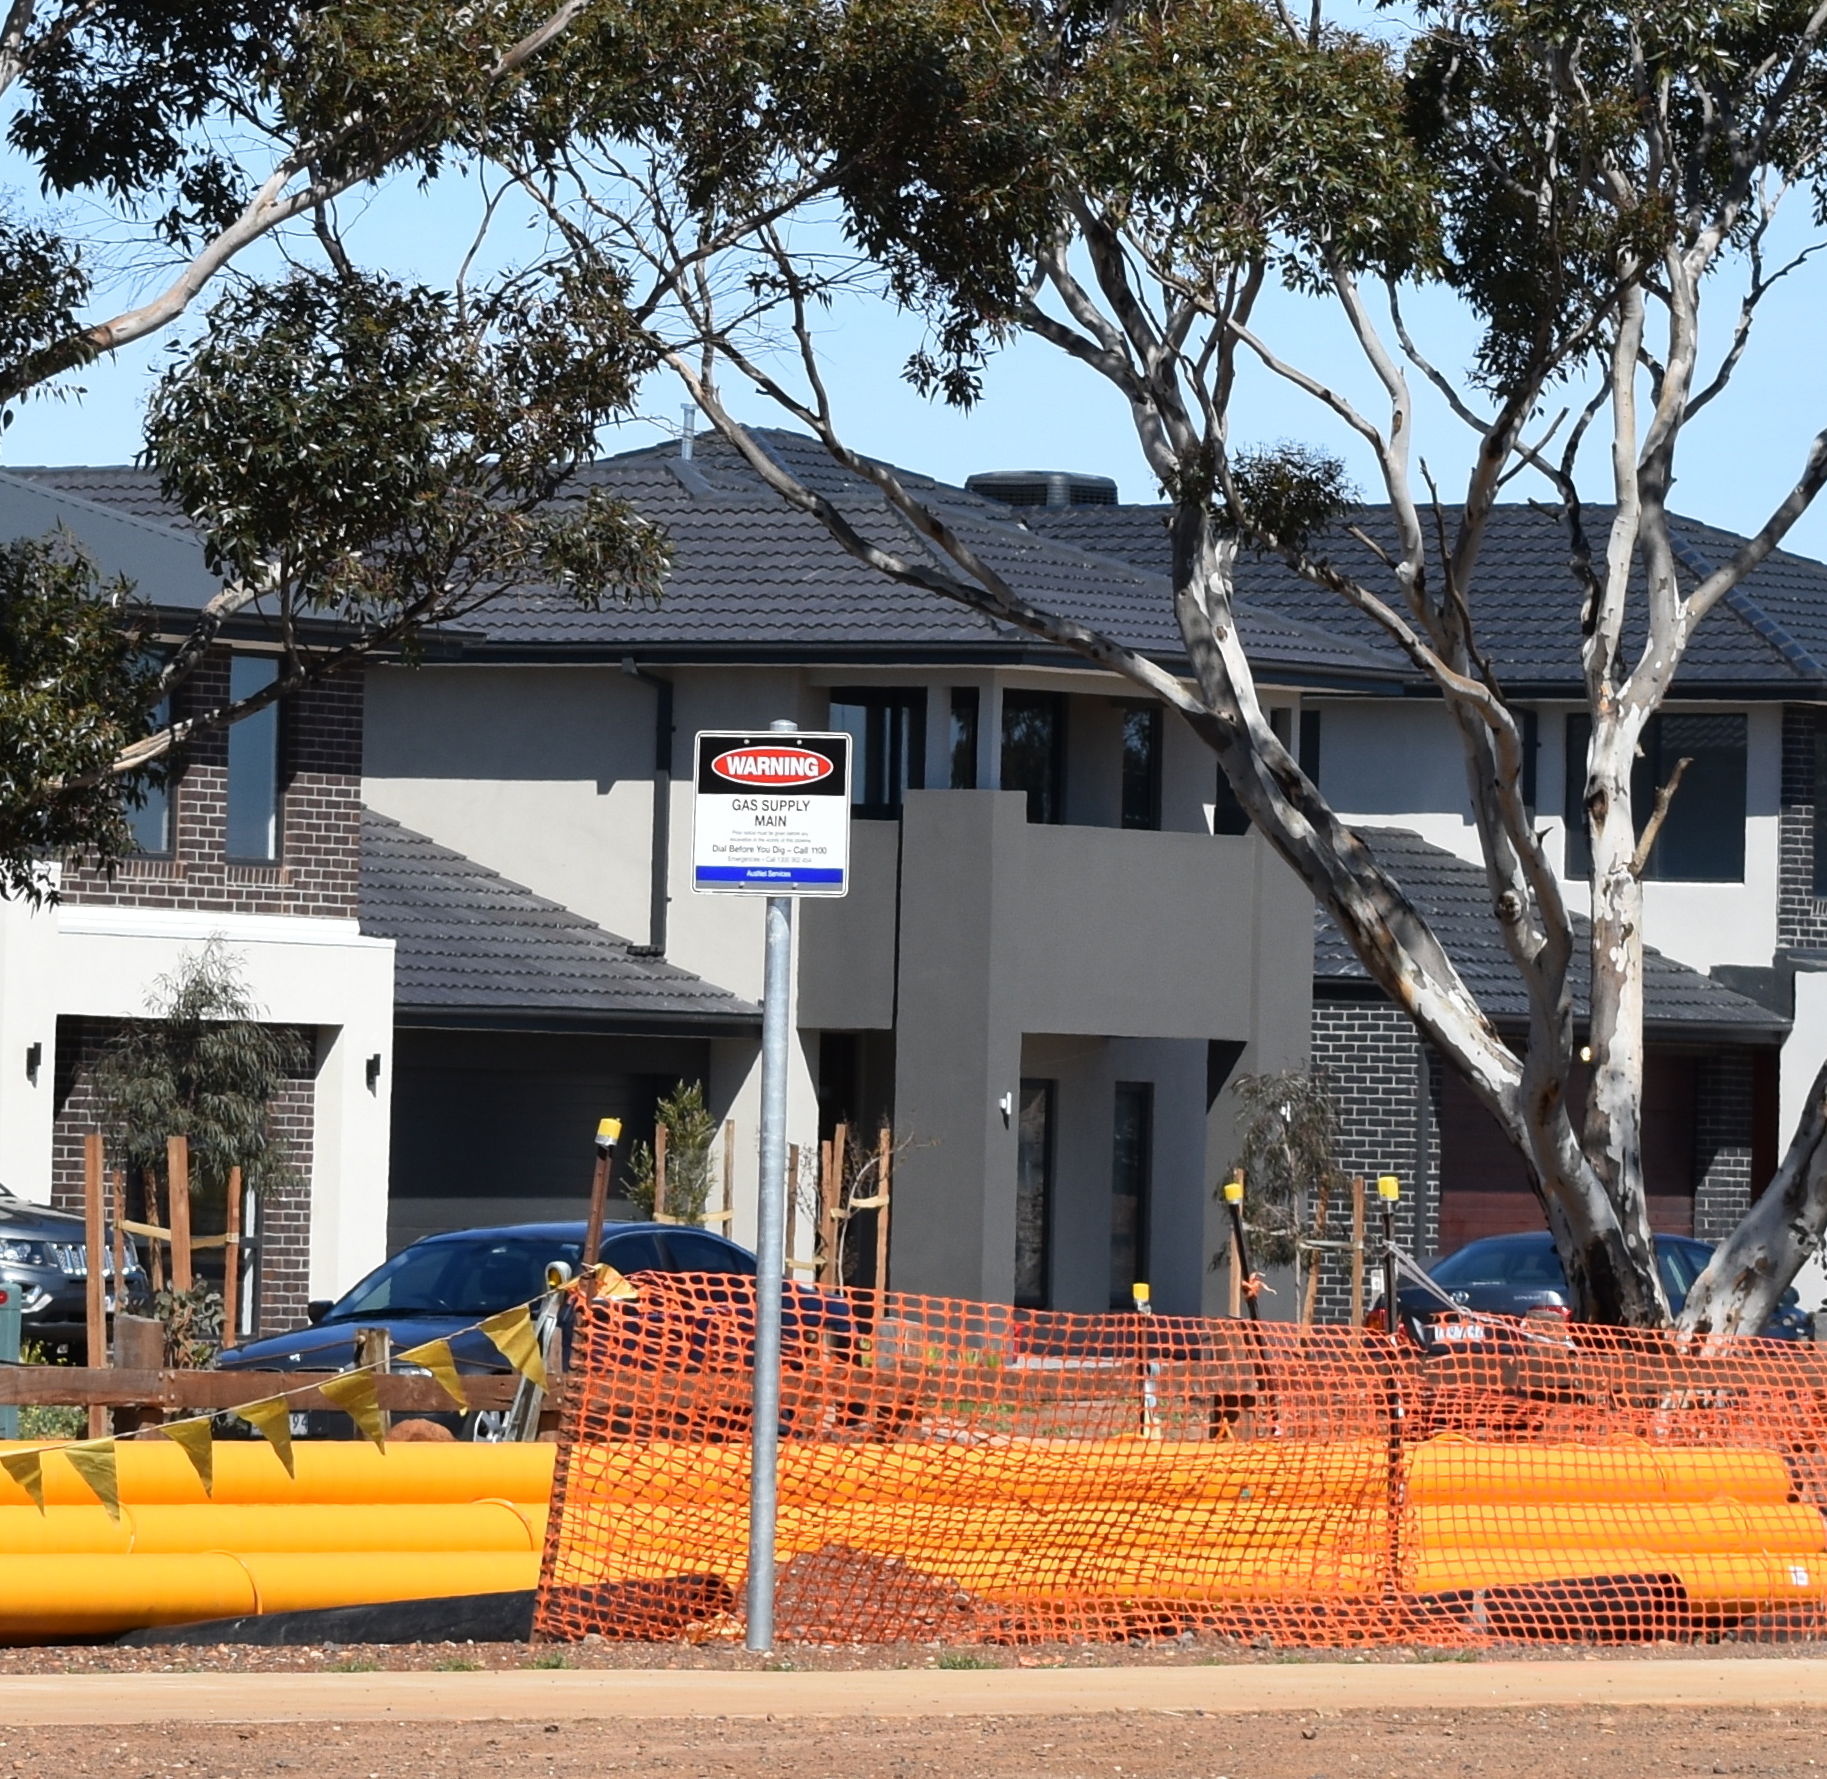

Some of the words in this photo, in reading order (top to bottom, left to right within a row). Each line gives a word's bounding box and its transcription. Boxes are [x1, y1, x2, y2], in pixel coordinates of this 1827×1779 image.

[726, 756, 819, 777] WARNING
[732, 799, 758, 811] GAS
[762, 800, 811, 812] SUPPLY
[754, 815, 787, 827] MAIN
[712, 844, 727, 853] Dial
[729, 845, 754, 853] Before
[757, 845, 770, 853] You
[773, 845, 786, 856] Dig
[793, 846, 808, 854] Call
[768, 870, 791, 878] Services
